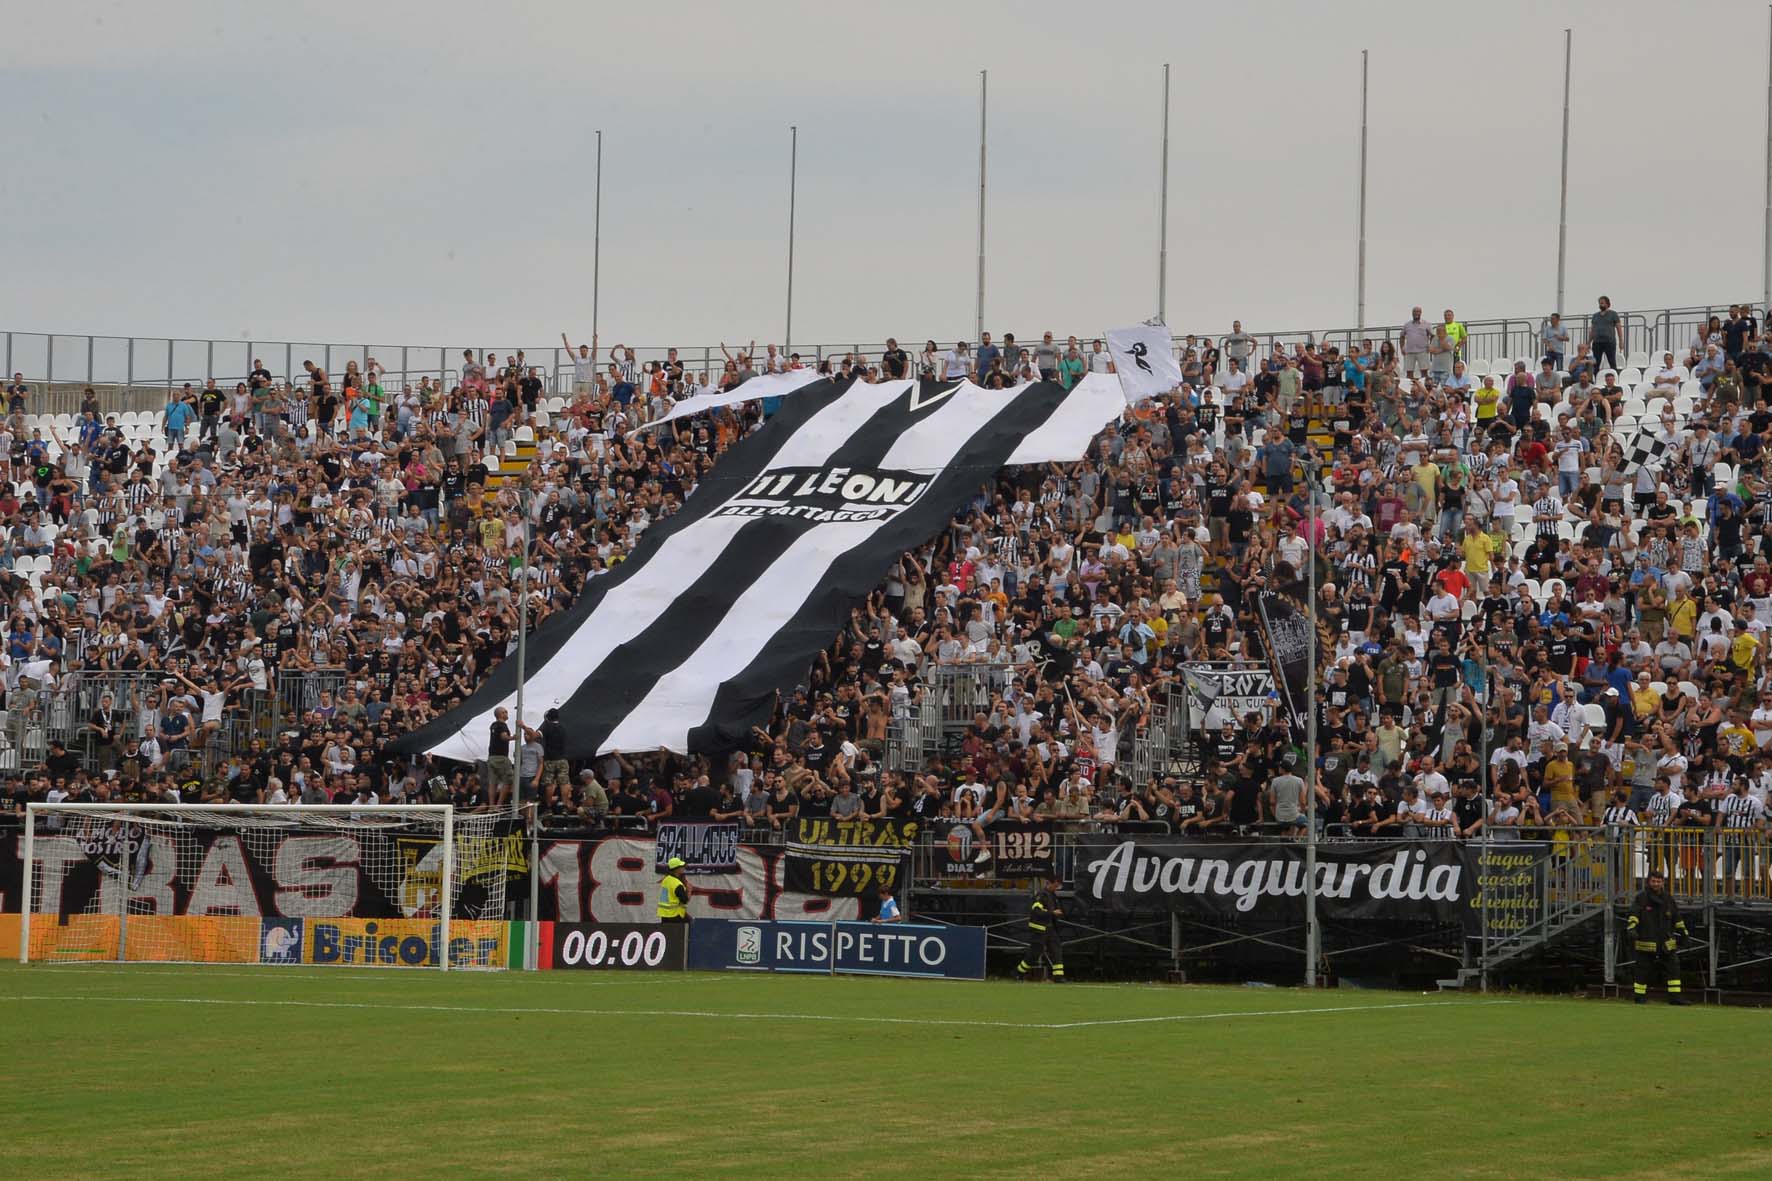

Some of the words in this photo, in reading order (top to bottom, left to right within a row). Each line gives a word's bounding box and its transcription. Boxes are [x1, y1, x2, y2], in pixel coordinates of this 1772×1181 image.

[749, 474, 795, 496] 11
[793, 467, 927, 503] LEONI
[799, 818, 919, 849] ULTRAS
[997, 832, 1051, 859] 1312
[811, 862, 897, 893] 1999
[947, 863, 974, 873] DIAZ
[1088, 840, 1462, 912] Avanguardia
[1487, 912, 1528, 930] edici
[562, 931, 667, 967] 00:00
[776, 931, 946, 966] RISPETTO
